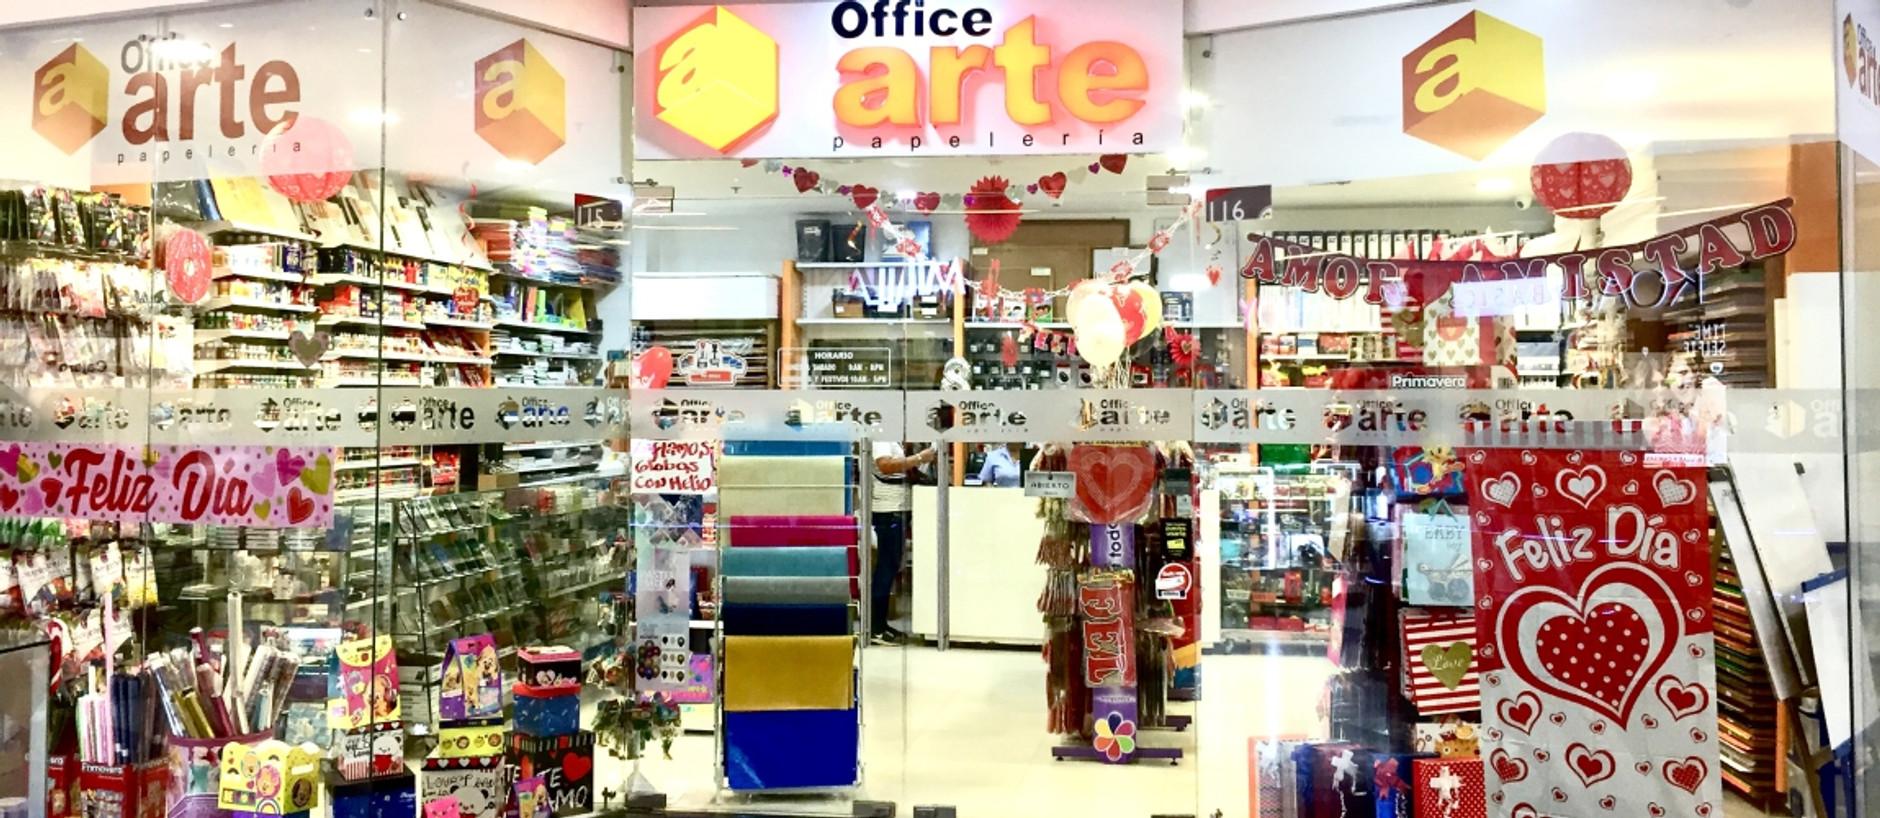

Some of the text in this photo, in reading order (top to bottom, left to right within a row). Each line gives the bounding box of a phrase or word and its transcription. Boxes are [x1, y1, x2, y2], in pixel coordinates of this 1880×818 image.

[832, 0, 993, 38] Office
[833, 15, 1150, 127] arte
[122, 42, 301, 145] arte
[833, 131, 1145, 151] papelería
[814, 352, 853, 360] HORARIO
[1391, 374, 1466, 389] Primavera
[1358, 402, 1427, 431] arte
[64, 448, 253, 522] Feliz Día
[1494, 505, 1679, 581] Feliz Día
